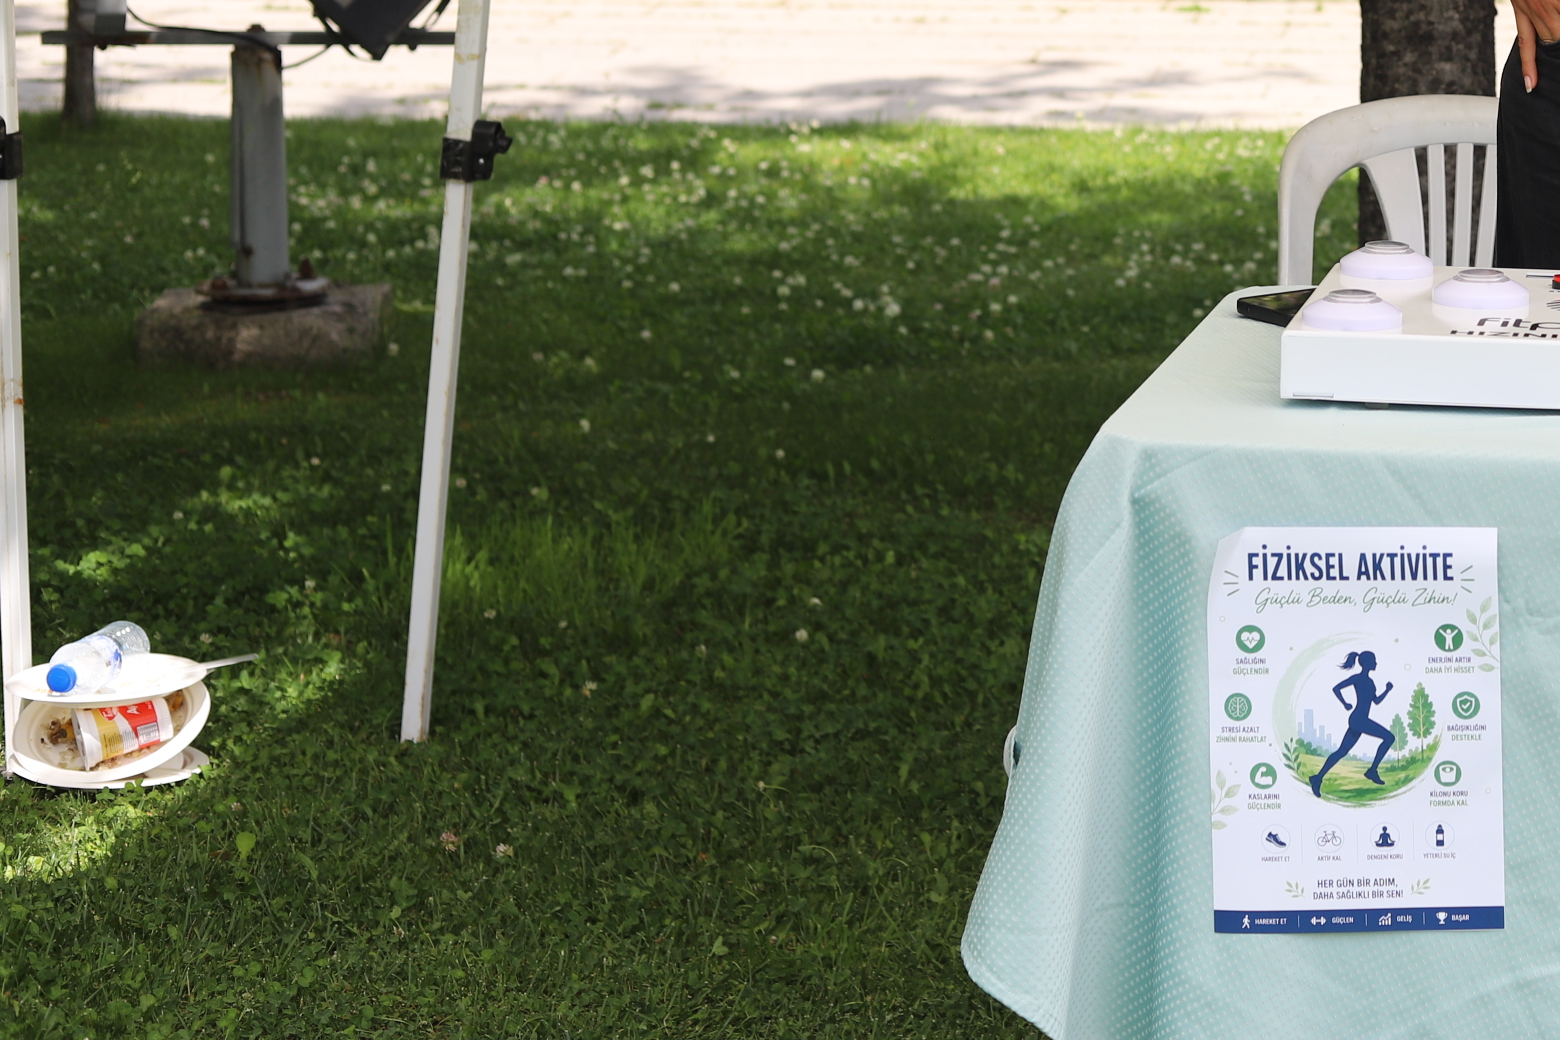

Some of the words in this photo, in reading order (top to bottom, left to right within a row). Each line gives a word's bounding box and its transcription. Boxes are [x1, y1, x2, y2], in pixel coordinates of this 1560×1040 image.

[1247, 544, 1350, 582] FİZİKSEL
[1356, 545, 1454, 581] AKTİVİTE
[1254, 587, 1303, 614] Güçlü
[1306, 587, 1357, 608] Beden,
[1362, 586, 1409, 613] Güçlü
[1411, 588, 1458, 607] Zihin!
[1235, 657, 1267, 665] SAĞLIĞINI
[1427, 656, 1454, 664] ENERJİNİ
[1455, 656, 1472, 664] ARTIR
[1232, 665, 1270, 676] GÜÇLENDİR
[1425, 666, 1442, 674] DAHA
[1443, 665, 1452, 674] İYİ
[1453, 664, 1475, 674] HİSSET
[1221, 725, 1240, 734] STRESİ
[1242, 726, 1260, 734] AZALT
[1446, 723, 1487, 733] BAĞIŞIKLIĞINI
[1215, 734, 1239, 743] ZİHNİNİ
[1240, 735, 1267, 743] RAHATLAT
[1451, 733, 1482, 741] DESTEKLE
[1248, 793, 1280, 801] KASLARINI
[1429, 790, 1452, 798] KİLONU
[1453, 790, 1469, 798] KORU
[1247, 801, 1282, 811] GÜÇLENDİR
[1429, 799, 1455, 807] FORMDA
[1456, 799, 1469, 807] KAL
[1317, 854, 1331, 862] AKTİF
[1366, 853, 1389, 861] DENGENİ
[1317, 879, 1334, 888] HER
[1335, 877, 1355, 888] GÜN
[1357, 876, 1371, 887] BİR
[1373, 878, 1398, 888] ADIM,
[1313, 891, 1334, 900] DAHA
[1335, 889, 1371, 900] SAĞLIKLI
[1372, 888, 1385, 898] BİR
[1386, 889, 1404, 898] SEN!
[1254, 917, 1278, 925] HAREKET
[1279, 917, 1287, 925] ET
[1331, 915, 1354, 925] GÜÇLEN
[1396, 914, 1413, 924] GELİŞ
[1451, 913, 1470, 923] BAŞAR
